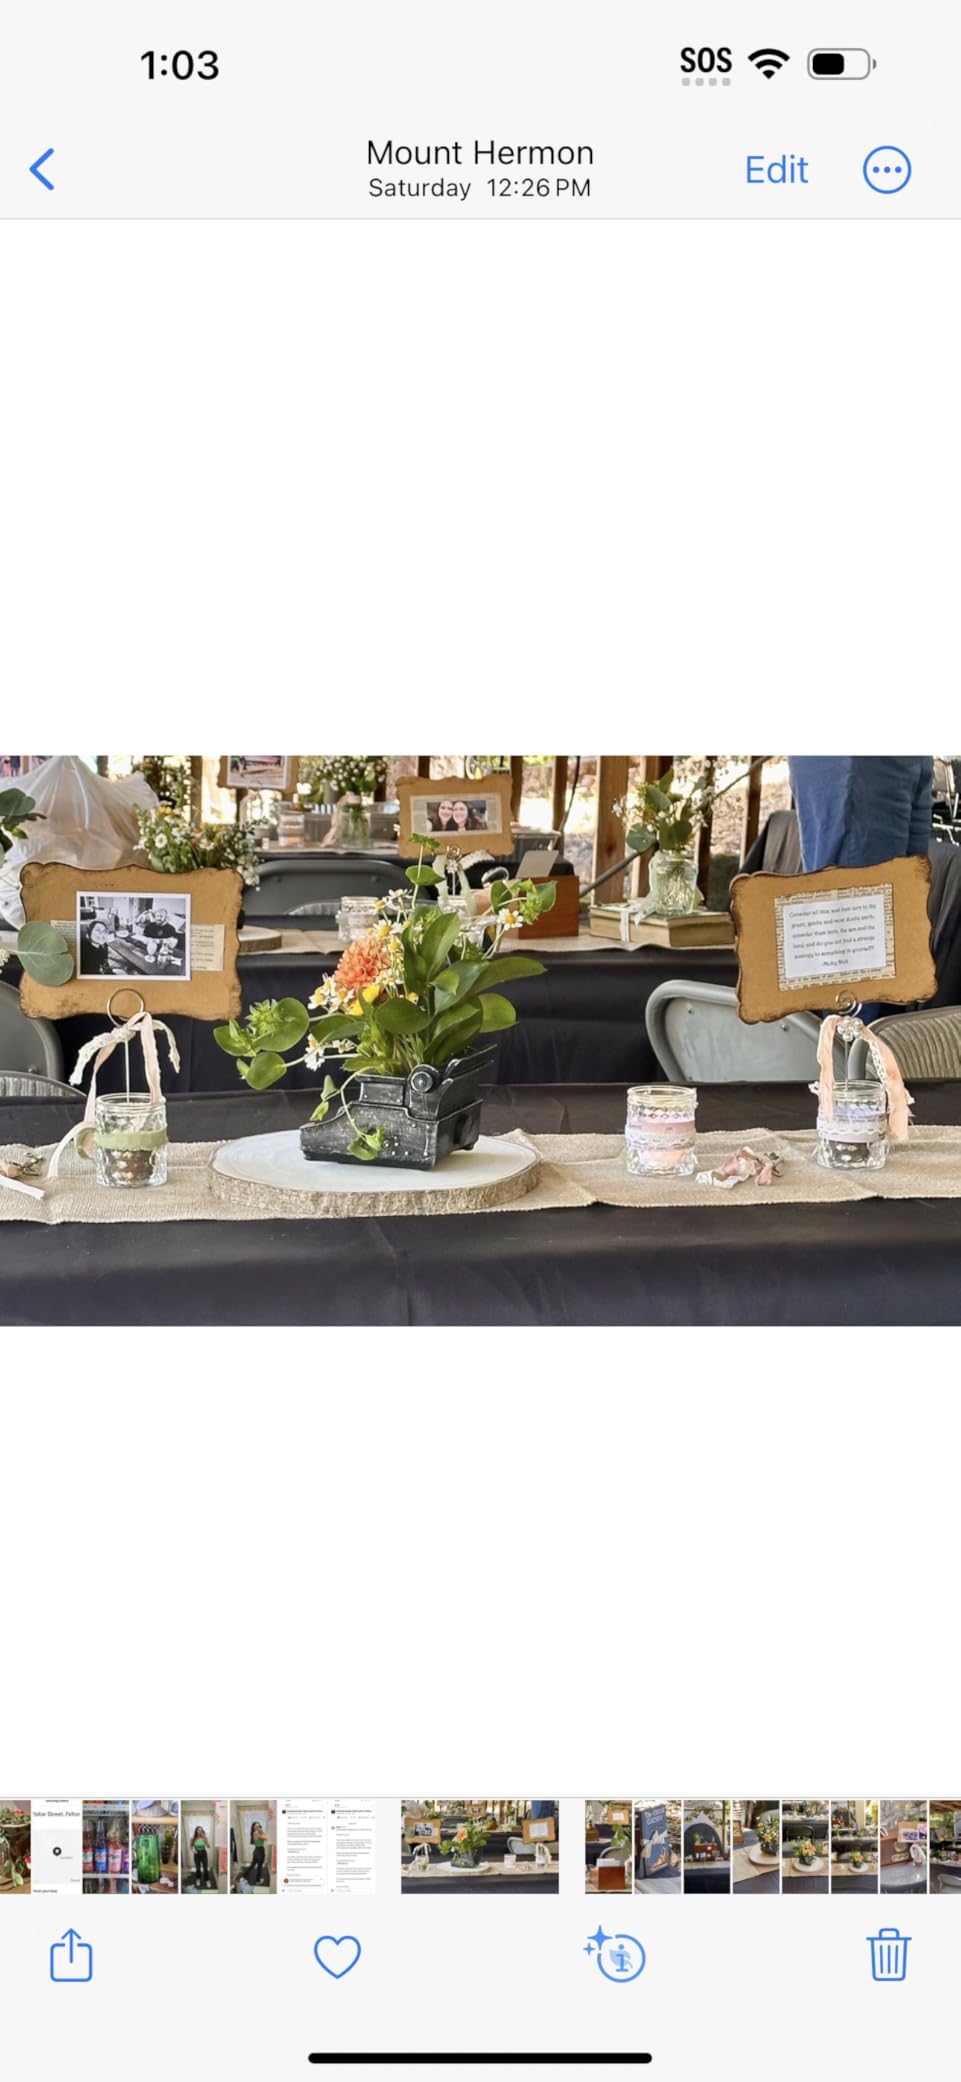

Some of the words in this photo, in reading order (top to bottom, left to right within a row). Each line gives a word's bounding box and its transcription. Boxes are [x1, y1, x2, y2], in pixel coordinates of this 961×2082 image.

[140, 50, 220, 81] 1:03
[680, 47, 732, 73] SOS
[367, 139, 463, 165] Mount
[474, 139, 594, 165] Hermon
[746, 153, 809, 183] Edit
[368, 177, 472, 201] Saturday
[487, 178, 551, 197] 12:26
[556, 178, 591, 197] PM
